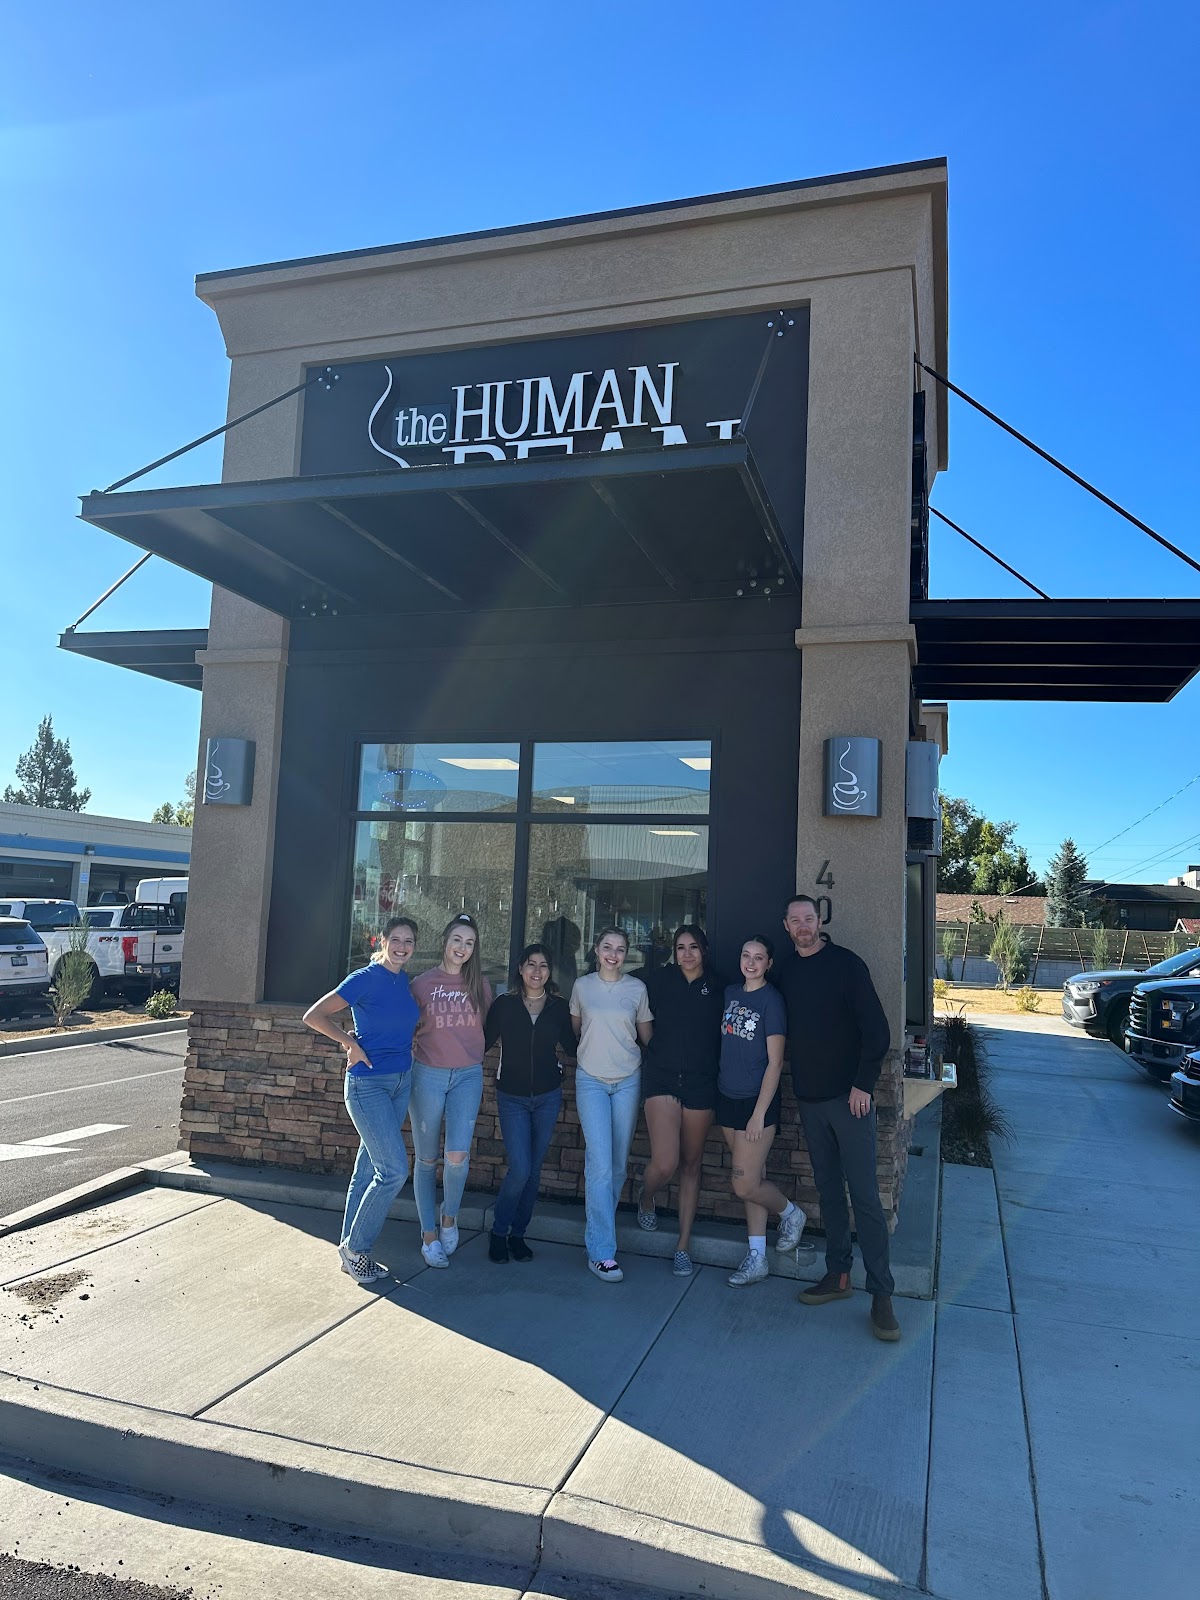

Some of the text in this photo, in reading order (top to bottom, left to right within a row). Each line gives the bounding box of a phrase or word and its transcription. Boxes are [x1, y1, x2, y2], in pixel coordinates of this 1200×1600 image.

[395, 407, 448, 447] the
[449, 362, 680, 444] HUMAN
[430, 984, 469, 1004] Happy
[426, 1000, 481, 1017] HUMA
[435, 1013, 477, 1029] BEAN
